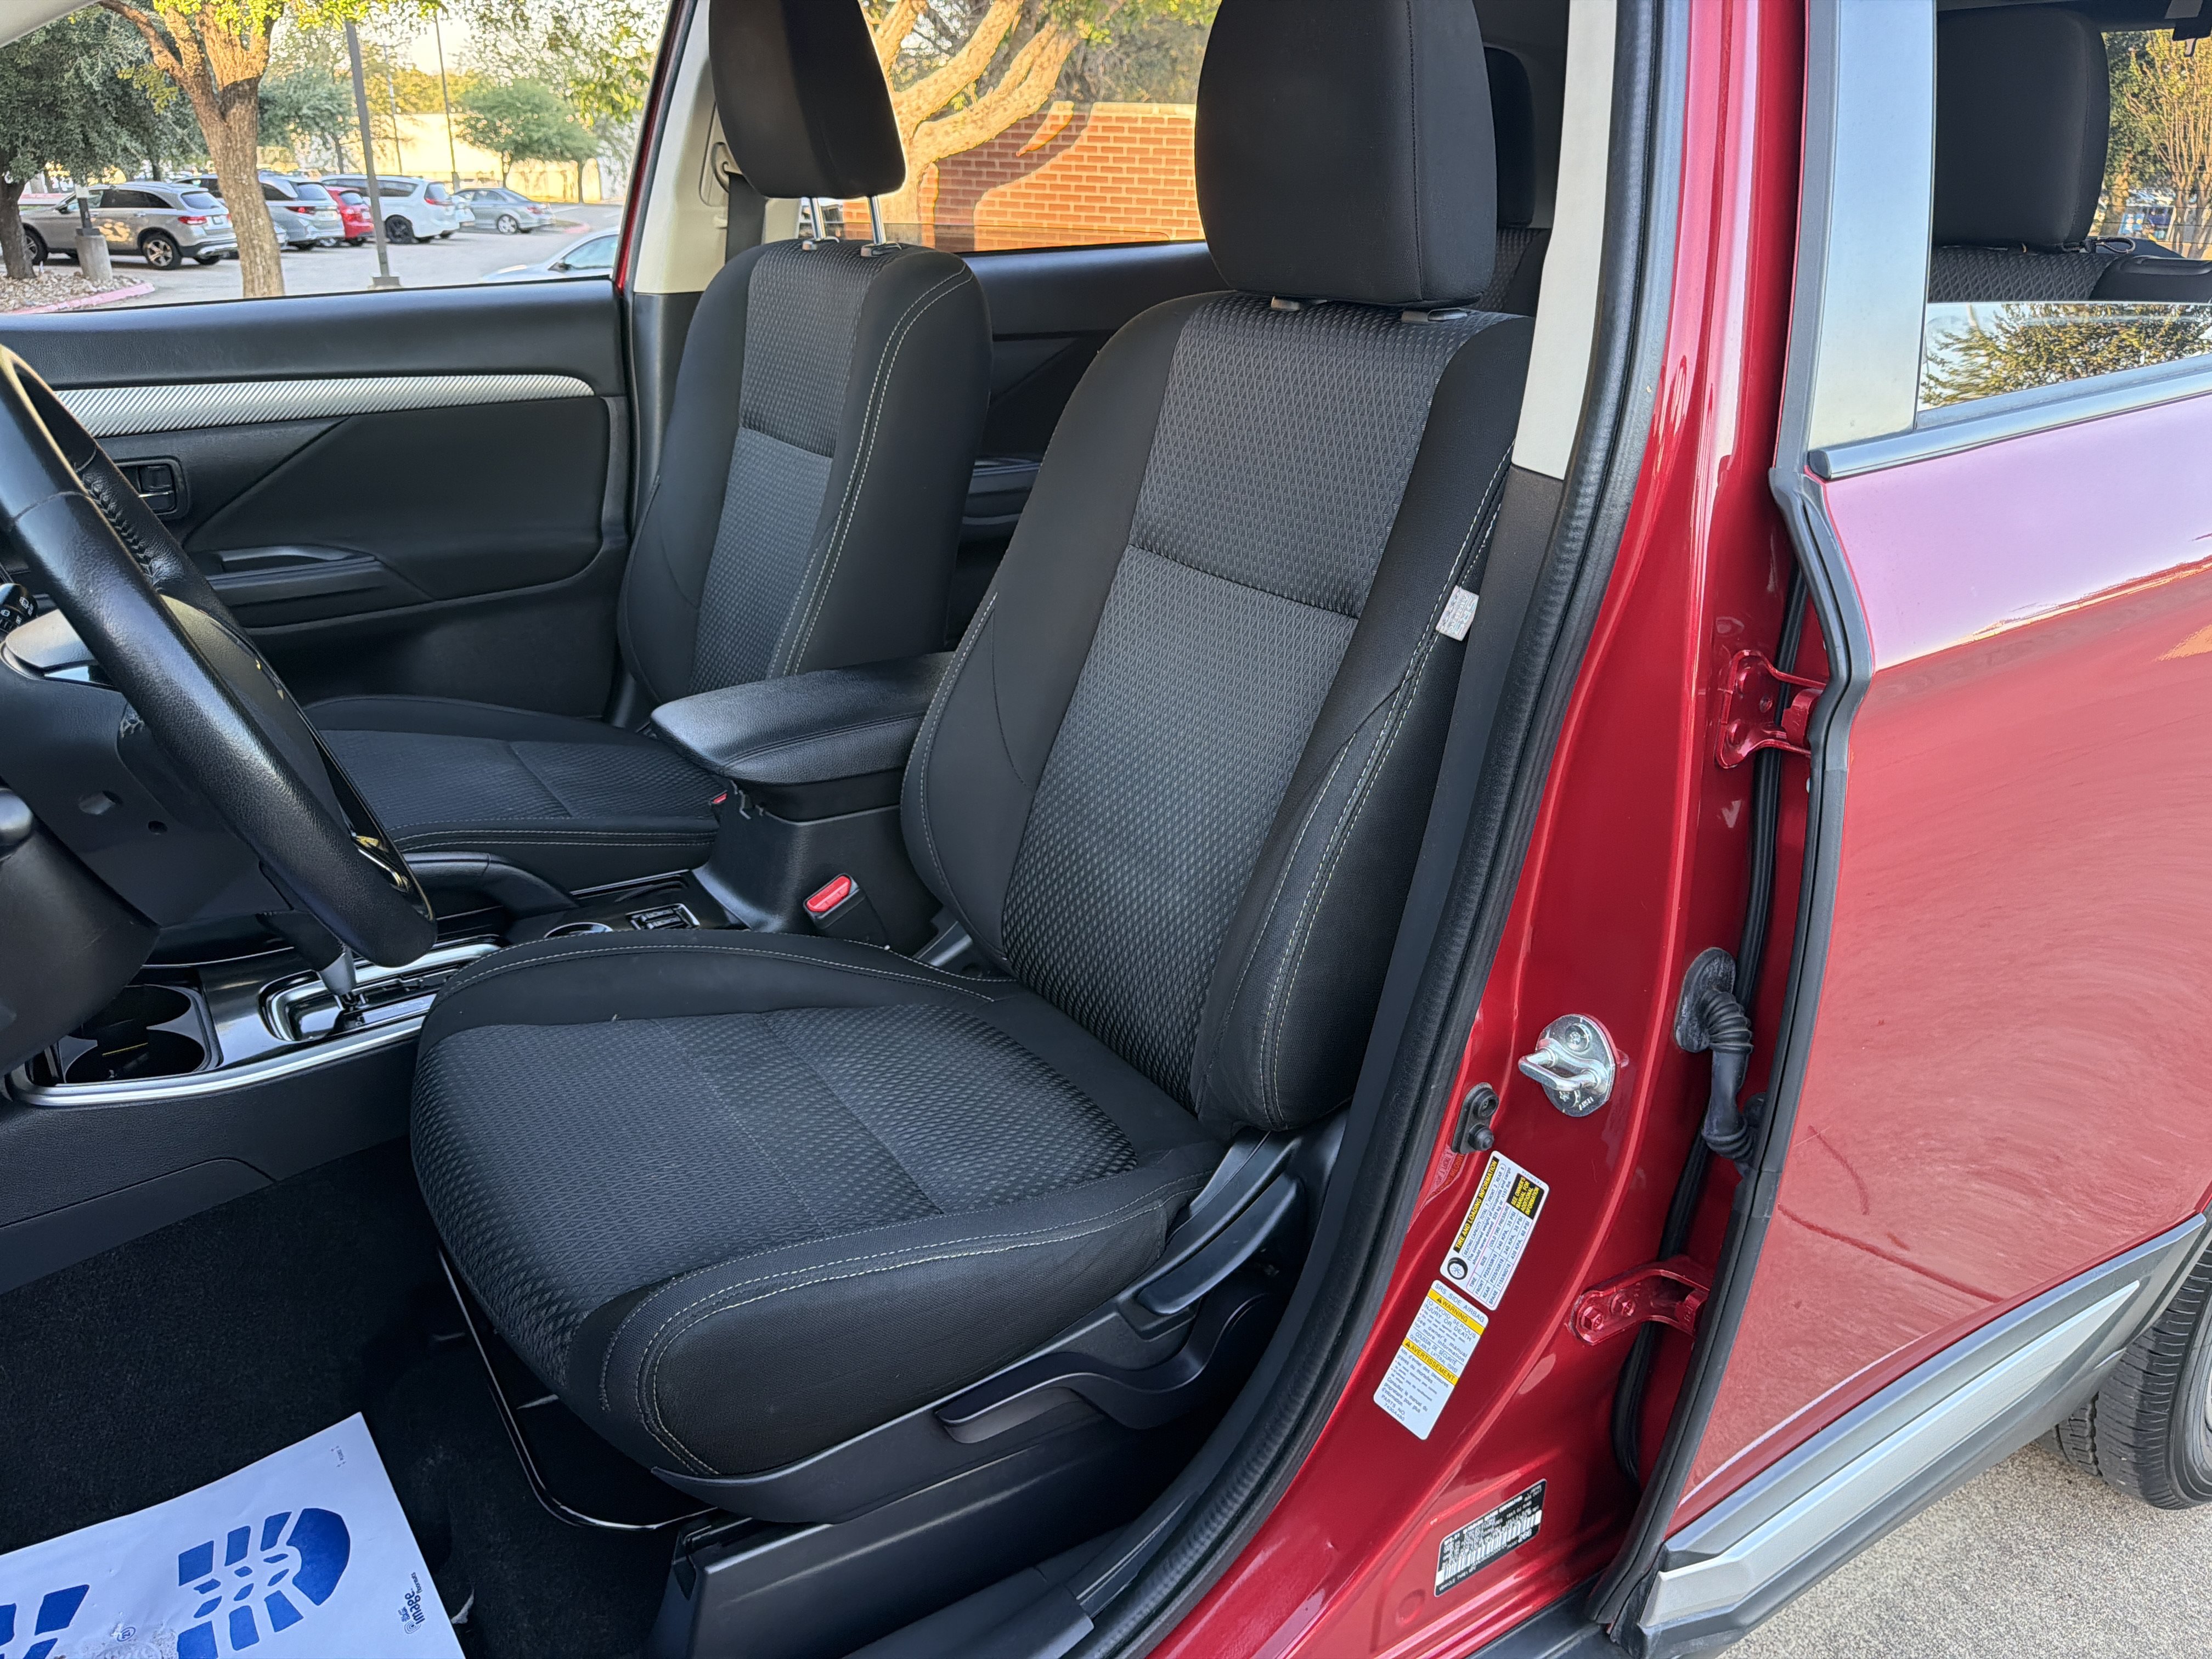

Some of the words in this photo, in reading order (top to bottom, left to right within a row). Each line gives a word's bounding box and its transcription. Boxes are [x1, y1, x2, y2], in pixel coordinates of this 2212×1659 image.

[1514, 1176, 1526, 1197] OWNER'S
[1515, 1190, 1526, 1209] MANUAL
[1520, 1186, 1534, 1211] ADDITIONAL
[1524, 1186, 1540, 1215] INFORMATION
[1455, 1234, 1465, 1249] TIRE
[1461, 1222, 1471, 1237] AND
[1467, 1197, 1481, 1223] LOADING
[1478, 1160, 1497, 1198] INFORMATION
[1471, 1231, 1483, 1253] combined
[1481, 1216, 1491, 1232] weight
[1490, 1189, 1503, 1212] occupants
[1503, 1167, 1512, 1180] cargo
[1464, 1238, 1473, 1255] SEATING
[1471, 1220, 1481, 1240] CAPACITY
[1479, 1207, 1487, 1220] TOTAL
[1487, 1188, 1496, 1202] FRONT
[1488, 1235, 1497, 1248] COLD
[1498, 1204, 1510, 1227] PRESSURE
[1471, 1249, 1481, 1265] should
[1485, 1221, 1494, 1237] exceed
[1475, 1279, 1485, 1295] FRONT
[1482, 1285, 1491, 1299] REAR
[1488, 1289, 1498, 1305] SPARE
[1423, 1302, 1442, 1319] INJURY
[1443, 1318, 1452, 1327] OR
[1426, 1298, 1434, 1306] TO
[1434, 1305, 1451, 1319] AVOID
[1452, 1318, 1476, 1339] SERIOUS
[1435, 1283, 1447, 1295] SRS
[1448, 1293, 1462, 1306] SIDE
[1463, 1304, 1485, 1323] AIRBAG
[1441, 1299, 1469, 1323] WARNING
[1415, 1331, 1431, 1346] COUSSIN
[1416, 1316, 1426, 1326] See
[1427, 1325, 1447, 1342] owner's
[1448, 1341, 1468, 1358] manual
[1423, 1328, 1435, 1340] more
[1437, 1339, 1465, 1363] information
[1410, 1344, 1455, 1382] AVERTISSEMENT
[1380, 1394, 1396, 1408] PARTS
[405, 1590, 425, 1624] image
